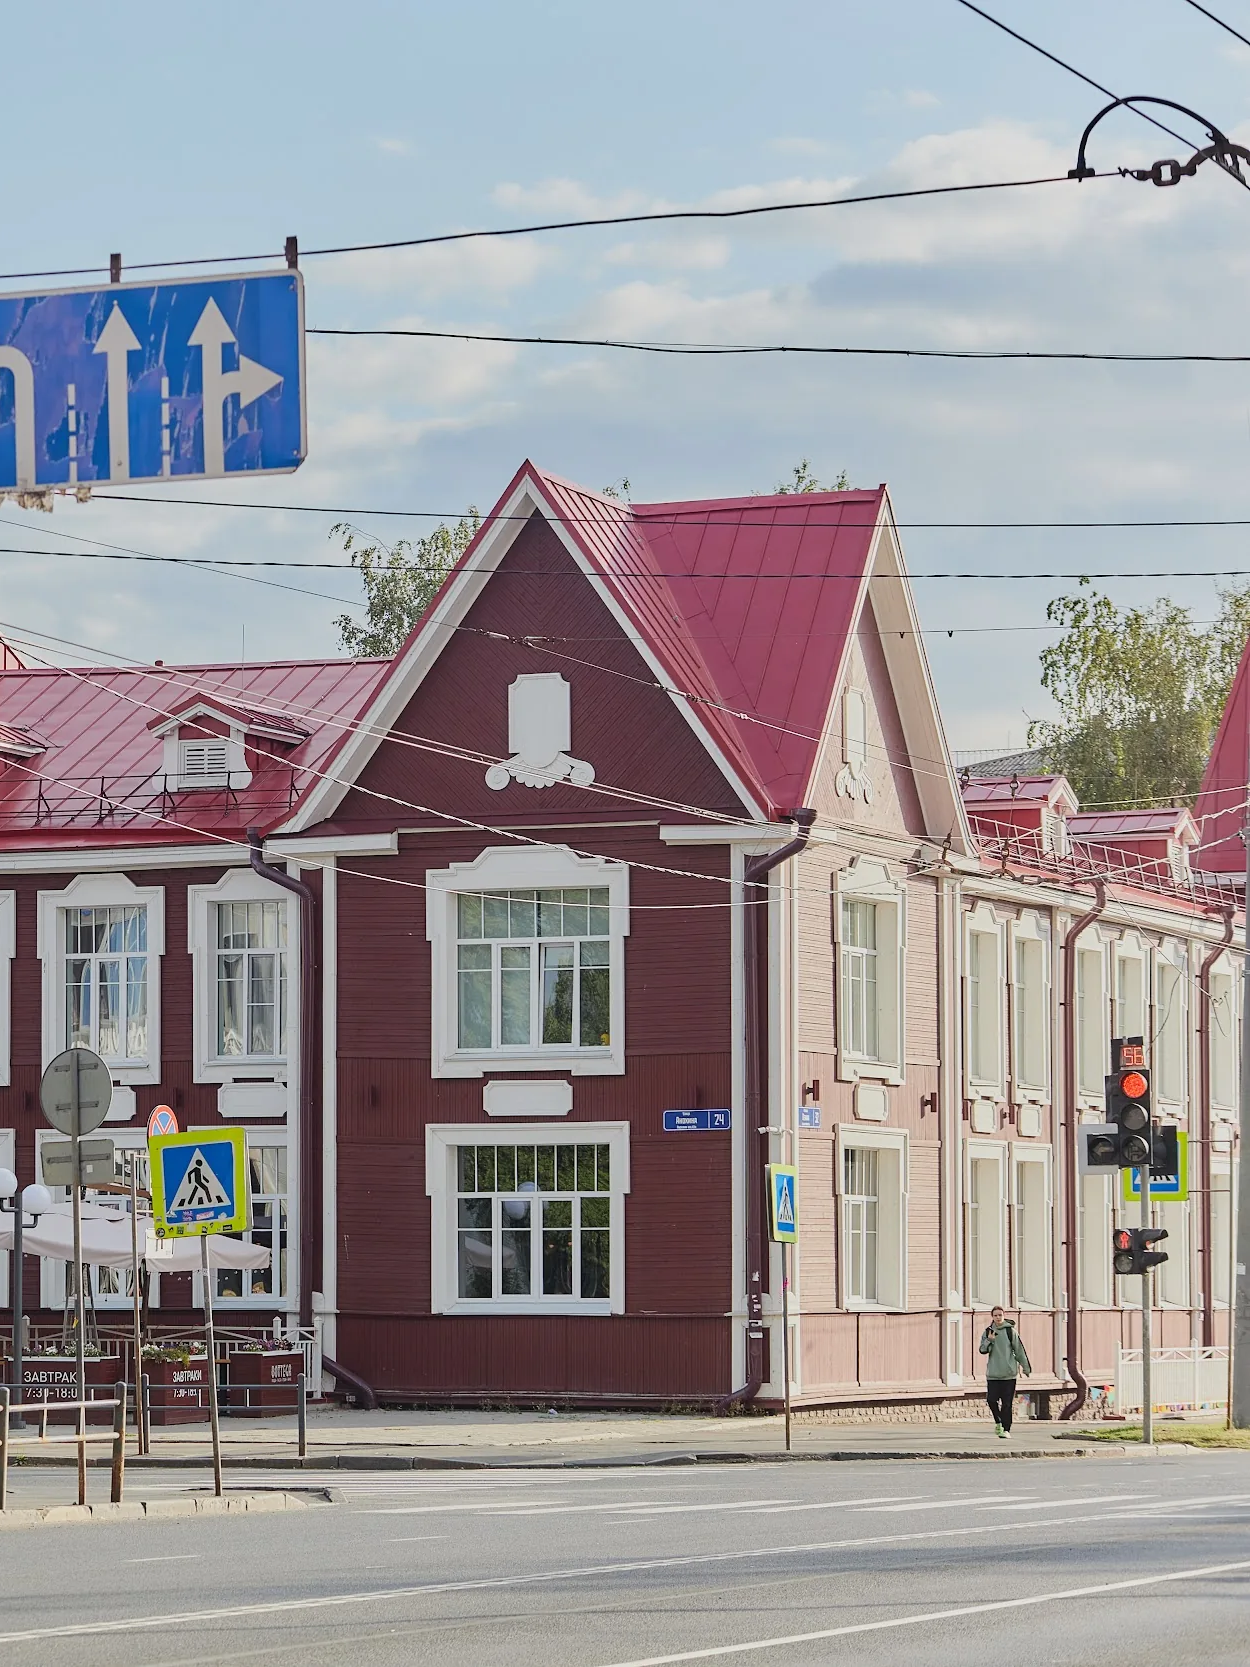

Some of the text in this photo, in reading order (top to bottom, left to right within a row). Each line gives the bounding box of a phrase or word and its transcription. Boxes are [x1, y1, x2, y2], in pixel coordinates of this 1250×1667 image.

[1123, 1046, 1144, 1066] 56
[714, 1113, 725, 1126] 24
[23, 1371, 78, 1383] ЗАВТРАК
[172, 1370, 202, 1383] ЗАВТРАКИ
